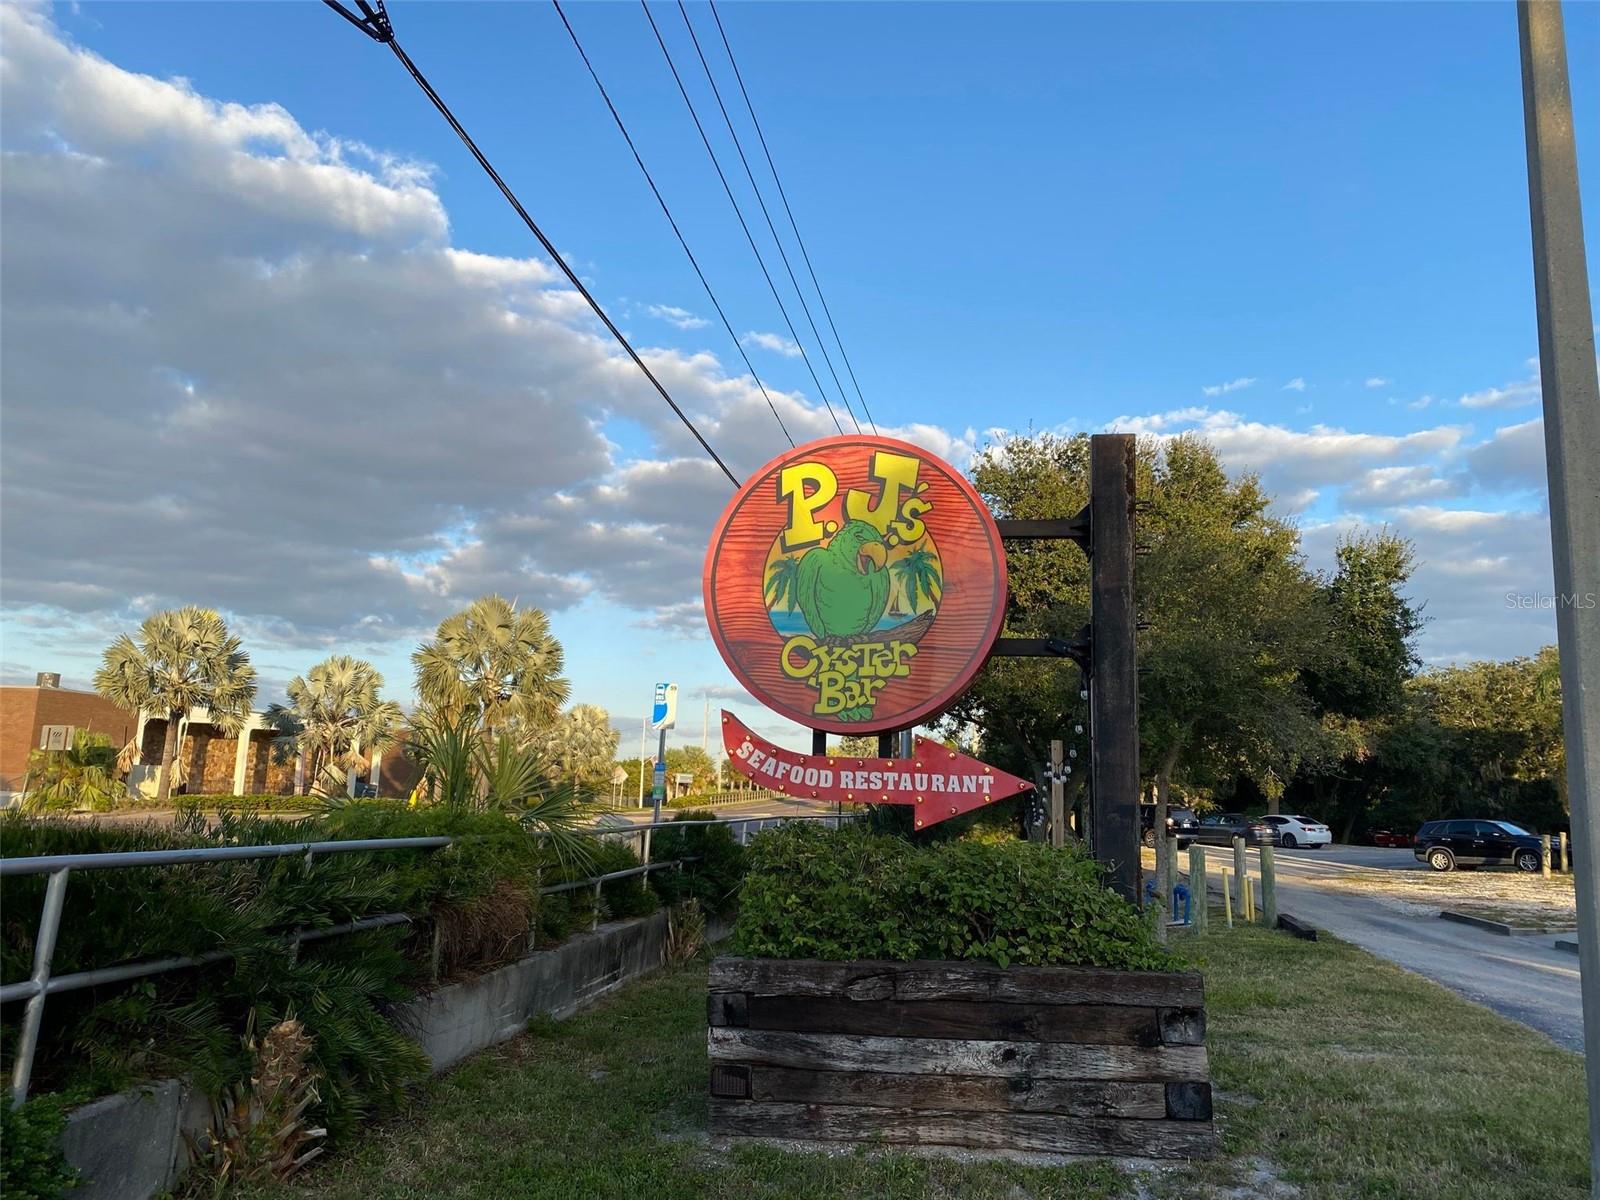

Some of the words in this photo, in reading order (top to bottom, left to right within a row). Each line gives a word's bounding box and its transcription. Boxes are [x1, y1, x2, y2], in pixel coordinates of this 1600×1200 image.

[812, 670, 888, 715] Bar
[735, 741, 834, 789] SEAFOOD
[839, 770, 994, 794] RESTAURANT
